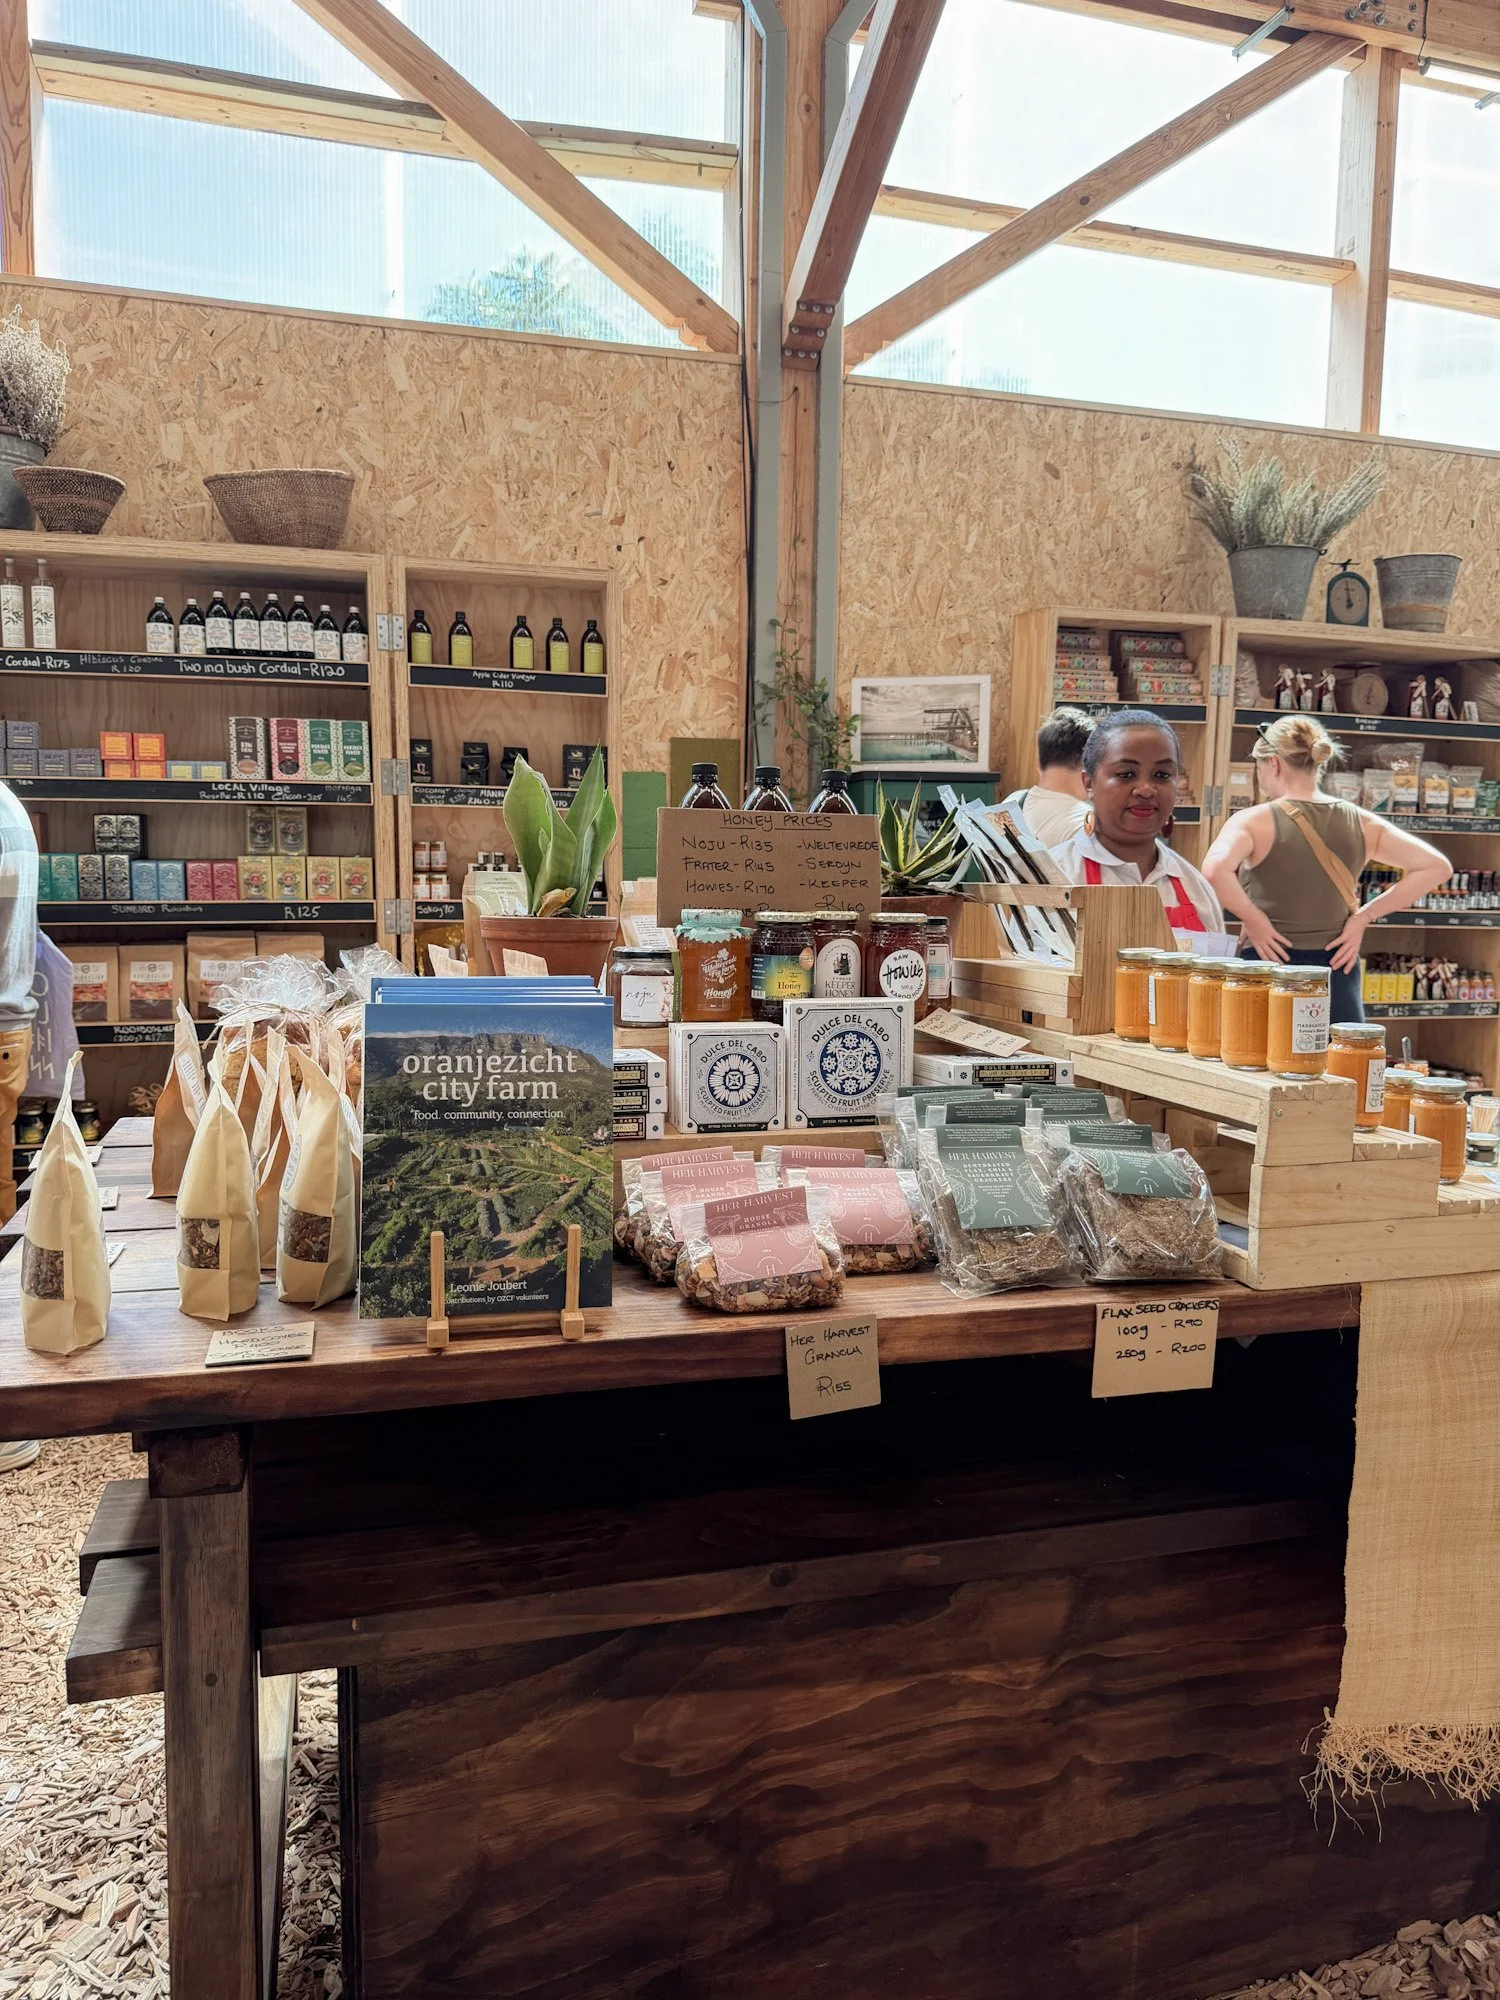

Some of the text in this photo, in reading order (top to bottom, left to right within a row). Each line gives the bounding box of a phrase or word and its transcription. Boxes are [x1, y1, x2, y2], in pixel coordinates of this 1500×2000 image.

[174, 659, 201, 672] Two
[226, 660, 256, 674] bush
[472, 670, 536, 682] Apple Cider Vinegar
[211, 783, 290, 794] LOCAL Village
[480, 789, 505, 798] MANN
[723, 812, 833, 832] HONEY PRICES
[682, 835, 773, 852] NOJU R135
[745, 859, 774, 873] R145
[744, 880, 775, 895] R170
[815, 894, 865, 912] R160
[893, 954, 909, 962] RAW
[703, 983, 738, 999] Honey
[777, 981, 801, 992] Honey
[825, 981, 856, 989] KEEPER
[825, 989, 855, 998] HONEY
[811, 1014, 890, 1043] DULCE DEL CABO
[700, 1041, 726, 1063] DULCE
[728, 1039, 744, 1048] DEL
[746, 1043, 768, 1063] CABO
[402, 1048, 578, 1081] oranjezicht
[423, 1074, 559, 1107] city farm
[809, 1068, 890, 1107] SCULPTED FRUIT PRESERVE
[699, 1085, 768, 1117] SCULPTED FRUIT PRESERVE
[414, 1108, 566, 1122] food. community. connection.
[652, 1151, 724, 1167] HER HARVEST
[791, 1150, 857, 1162] HER HARVEST
[948, 1151, 1017, 1161] HER HARVEST
[672, 1164, 746, 1179] HER HARVEST
[818, 1170, 888, 1180] HER HARVEST
[716, 1190, 796, 1213] HER HARVEST
[739, 1219, 778, 1230] GRANOLA
[743, 1213, 771, 1223] HOUSE
[450, 1280, 527, 1293] Leonie Joubert
[445, 1293, 549, 1304] ontributions by OZCF volunteers
[1101, 1299, 1220, 1320] FLAX SEED CRACKERS
[222, 1326, 285, 1337] BOOKS
[790, 1325, 871, 1347] HER HARVEST
[1117, 1318, 1203, 1340] 100g R90
[804, 1345, 863, 1365] GRANOLA
[1115, 1342, 1207, 1362] 250g R200
[816, 1375, 852, 1398] R155
